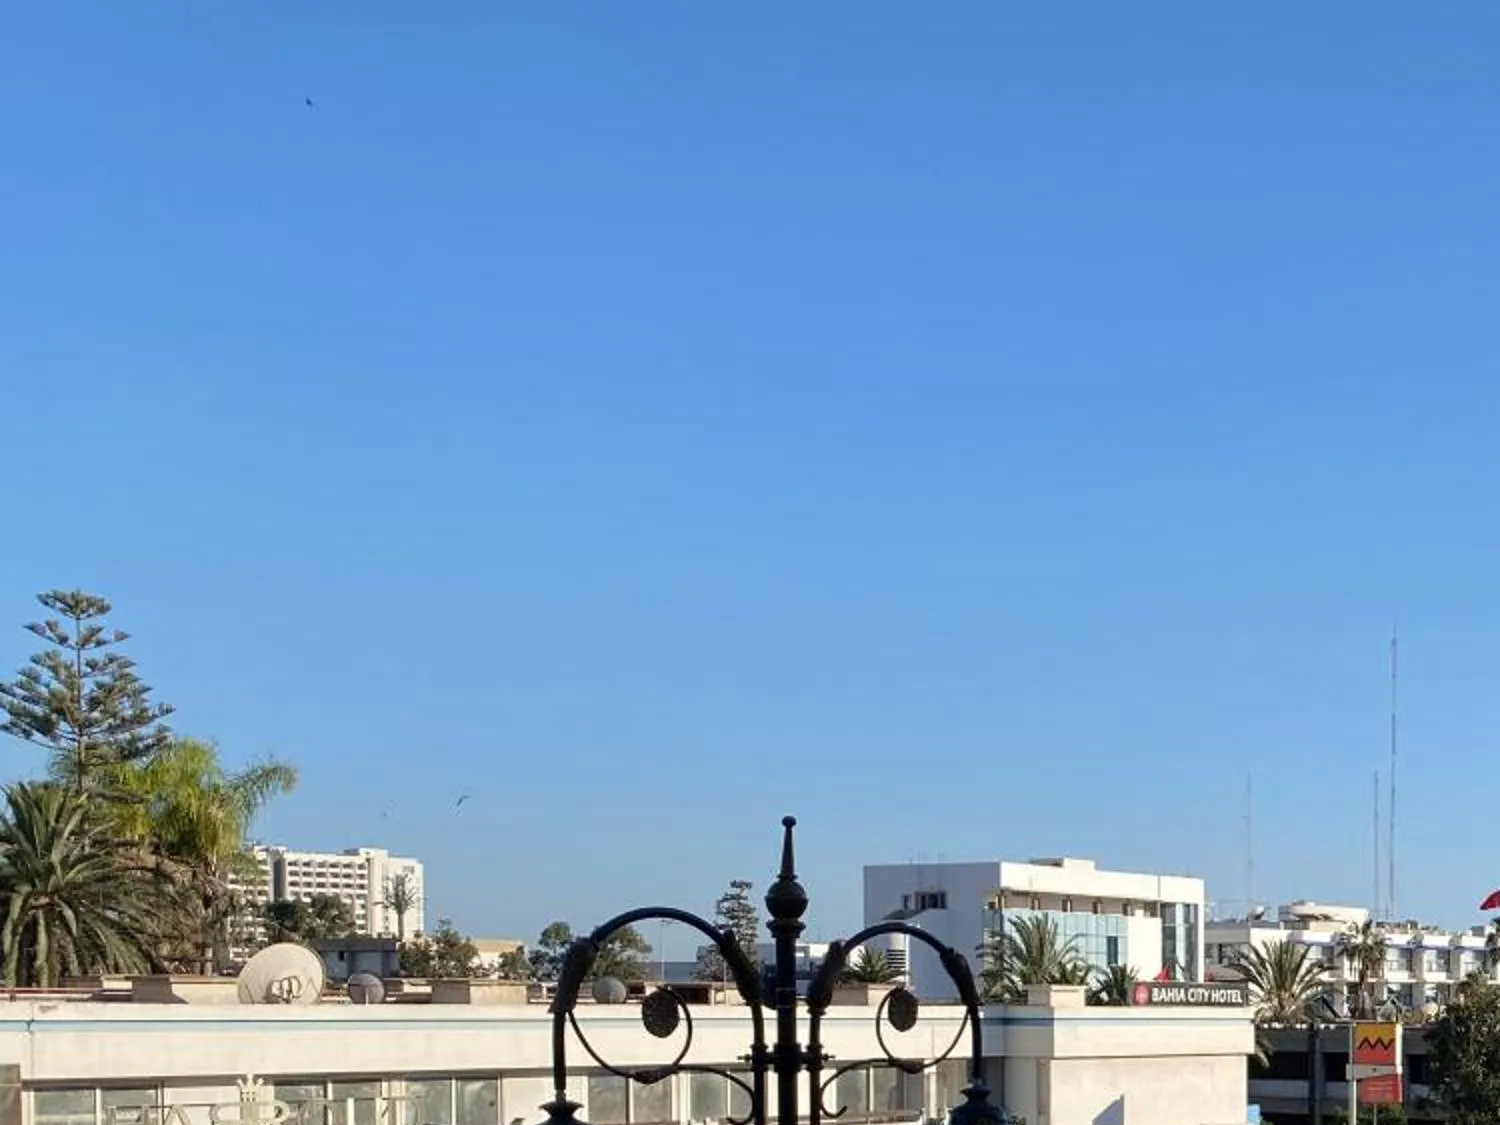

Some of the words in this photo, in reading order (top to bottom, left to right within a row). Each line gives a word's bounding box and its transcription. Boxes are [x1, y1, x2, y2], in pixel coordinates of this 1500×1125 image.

[1151, 986, 1186, 1003] BAHIA
[1187, 987, 1210, 1003] CITY
[1210, 988, 1243, 1003] HOTEL
